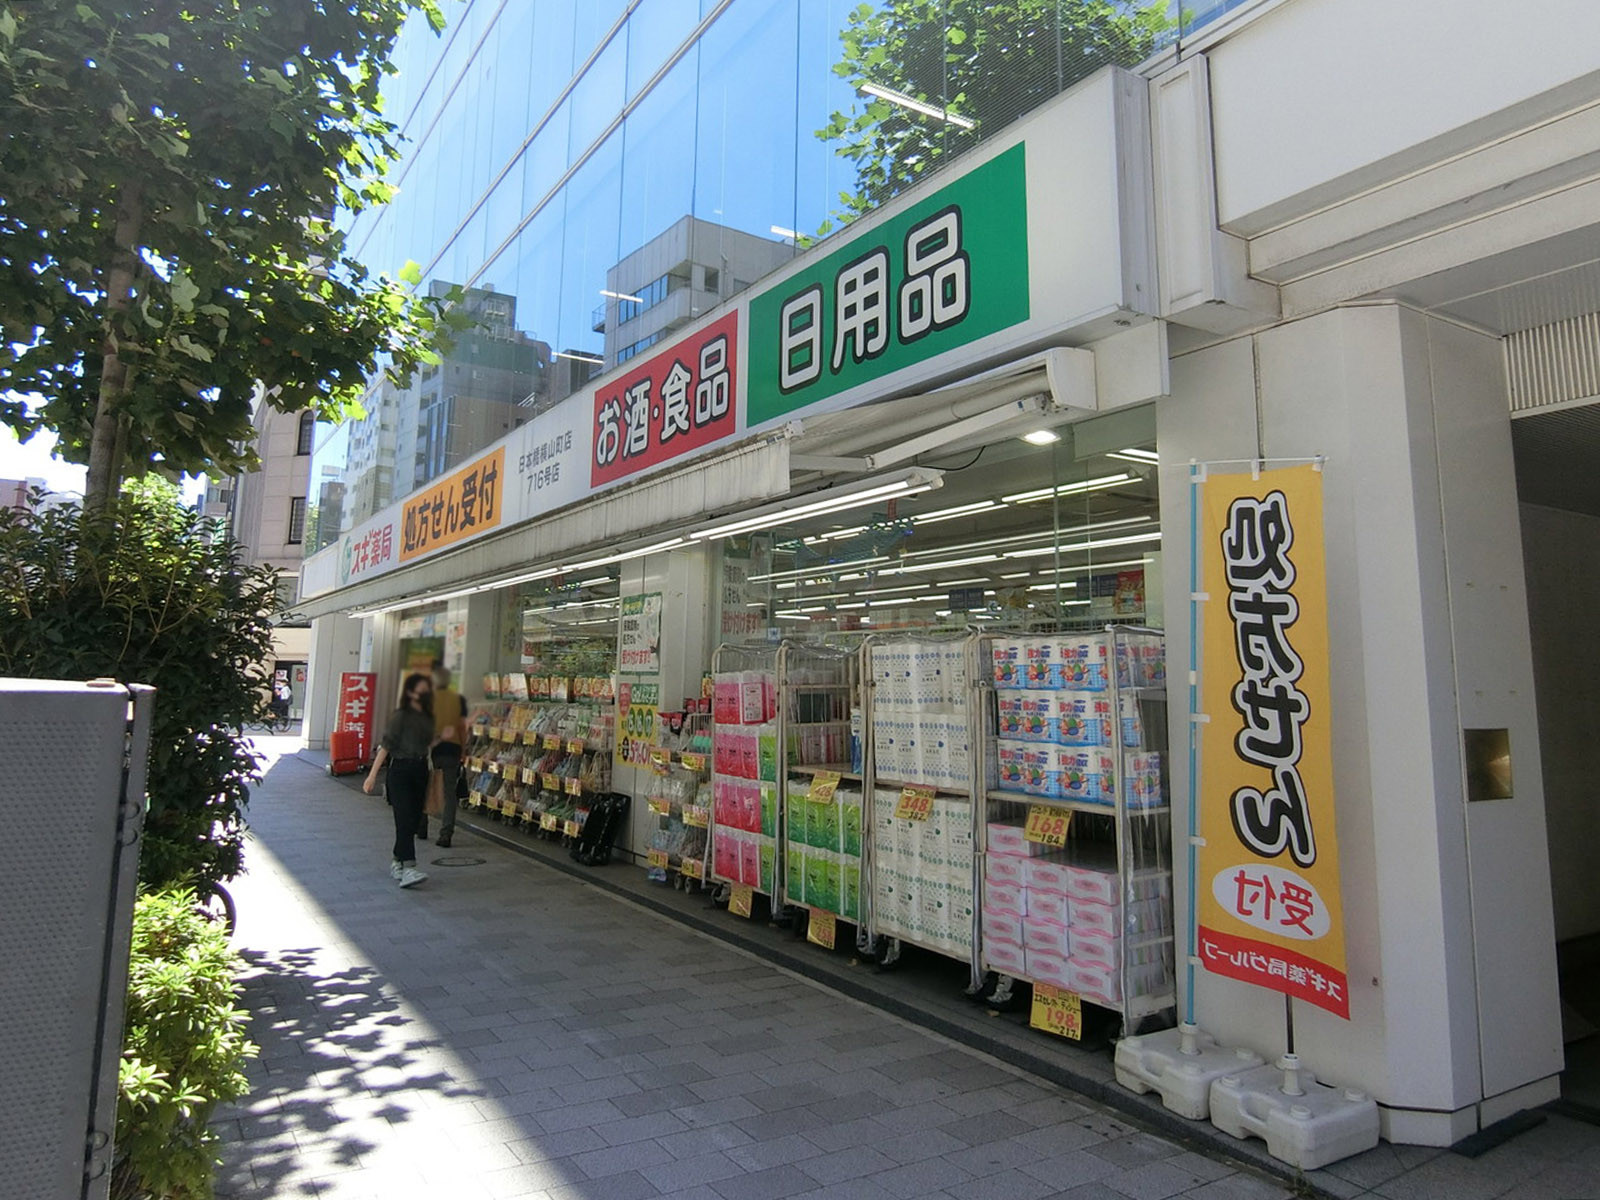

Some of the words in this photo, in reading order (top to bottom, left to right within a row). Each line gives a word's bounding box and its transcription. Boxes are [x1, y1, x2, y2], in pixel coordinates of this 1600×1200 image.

[778, 204, 970, 395] 日用品
[595, 333, 730, 468] お酒・食品
[519, 430, 572, 474] 日本橋横山町店
[527, 462, 560, 494] 716号店
[404, 460, 497, 553] 処方せん受付
[351, 524, 392, 575] スギ薬局
